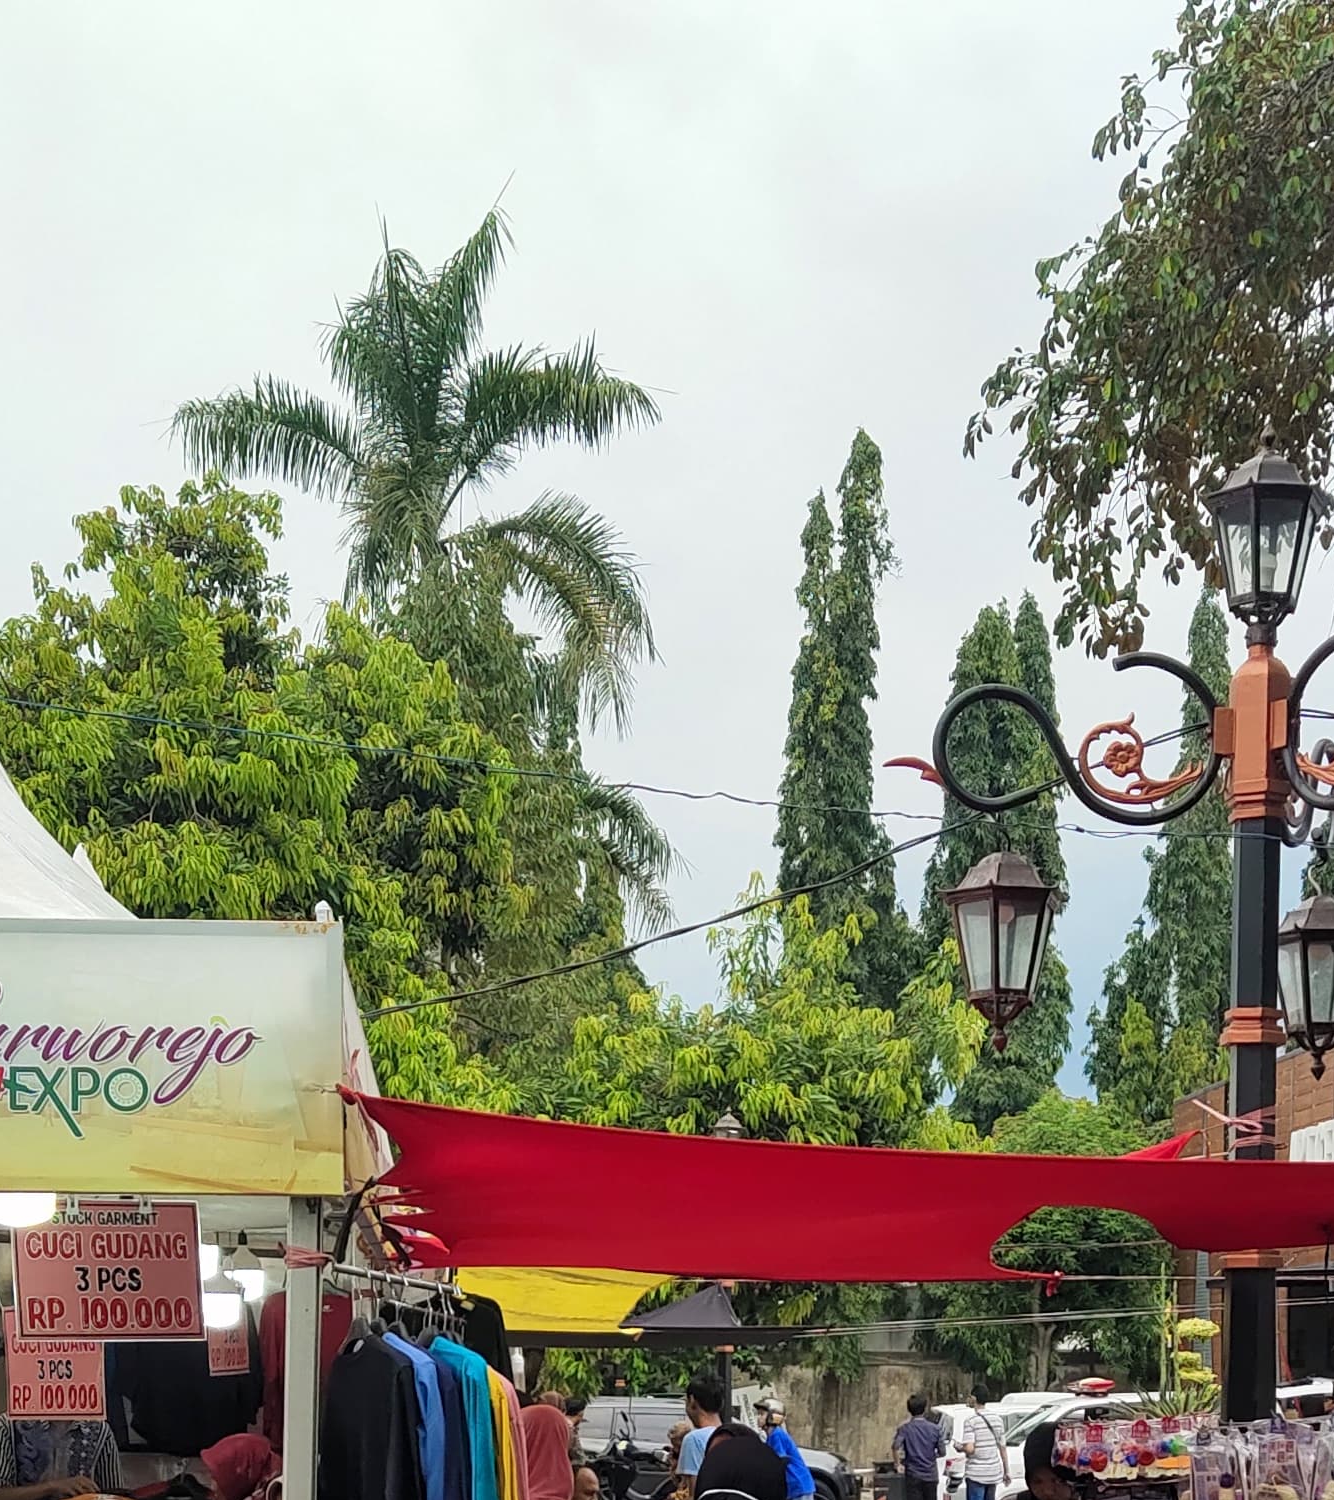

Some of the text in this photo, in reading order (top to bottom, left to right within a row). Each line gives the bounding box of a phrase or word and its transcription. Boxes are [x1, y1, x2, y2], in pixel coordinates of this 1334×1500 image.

[1, 1064, 154, 1140] EXPO
[51, 1211, 159, 1227] STOCK GARMENT
[24, 1231, 189, 1261] CUCI GUDANG
[74, 1266, 143, 1293] 3 PCS
[25, 1296, 194, 1331] RP. 100.000
[36, 1359, 73, 1380] 3 PCS
